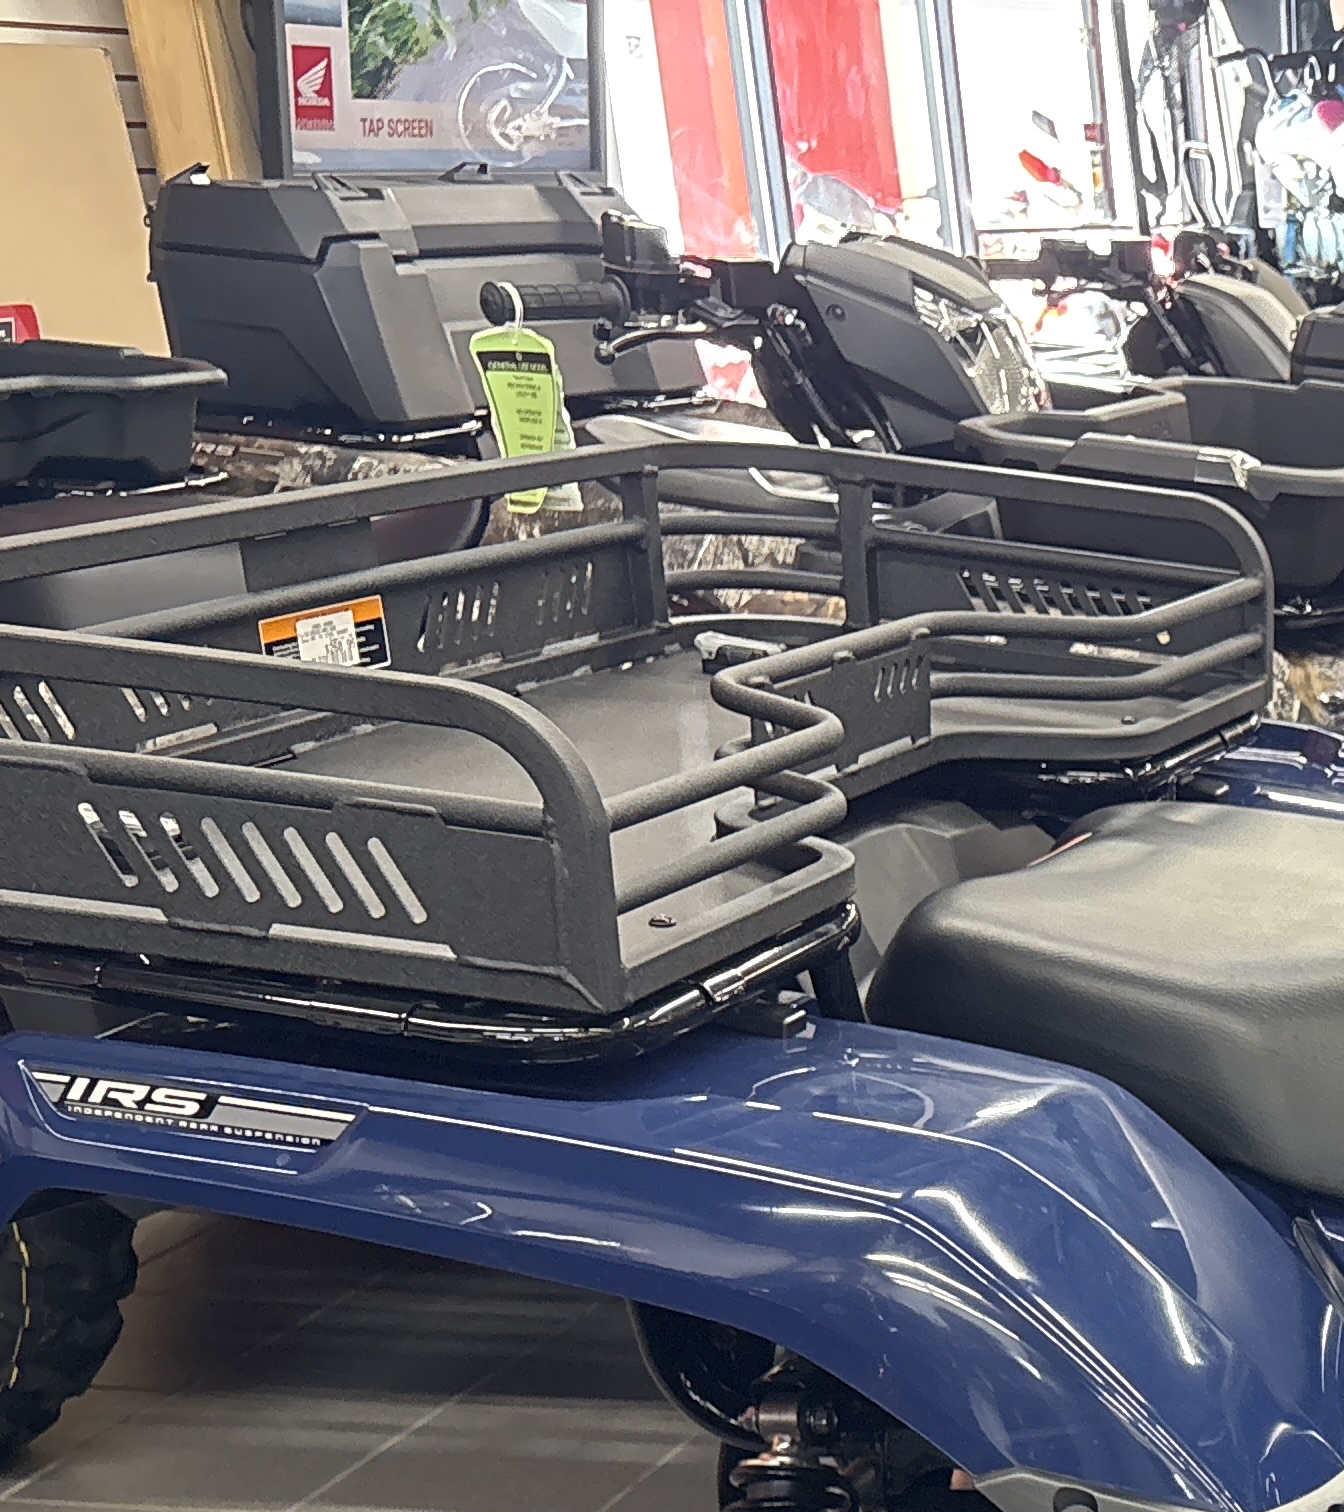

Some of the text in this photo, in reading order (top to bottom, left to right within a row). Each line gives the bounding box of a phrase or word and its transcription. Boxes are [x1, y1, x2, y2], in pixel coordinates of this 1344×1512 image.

[360, 118, 433, 138] TAP SCREEN
[66, 1077, 207, 1117] IRS
[67, 1105, 322, 1147] INDEPENDENT REAR SUSPENSION
